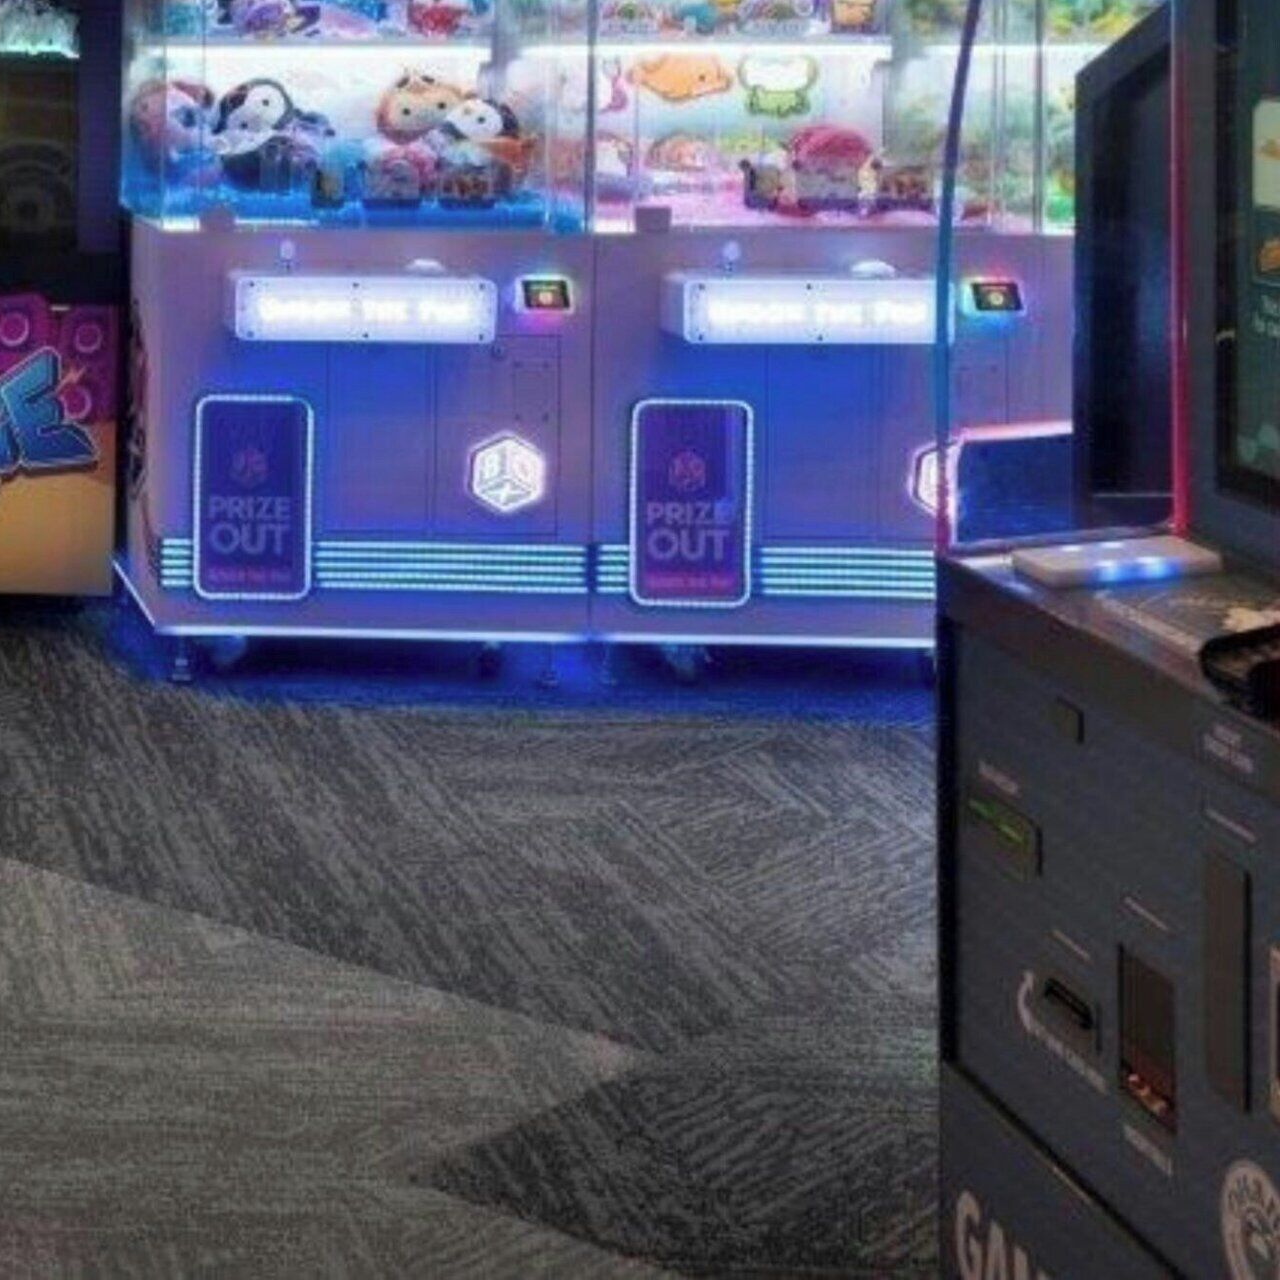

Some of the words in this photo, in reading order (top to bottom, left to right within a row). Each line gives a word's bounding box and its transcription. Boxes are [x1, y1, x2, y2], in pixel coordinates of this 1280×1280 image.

[210, 495, 291, 518] PRIZE
[647, 502, 732, 526] PRIZE
[211, 524, 289, 555] OUT
[648, 531, 729, 561] OUT
